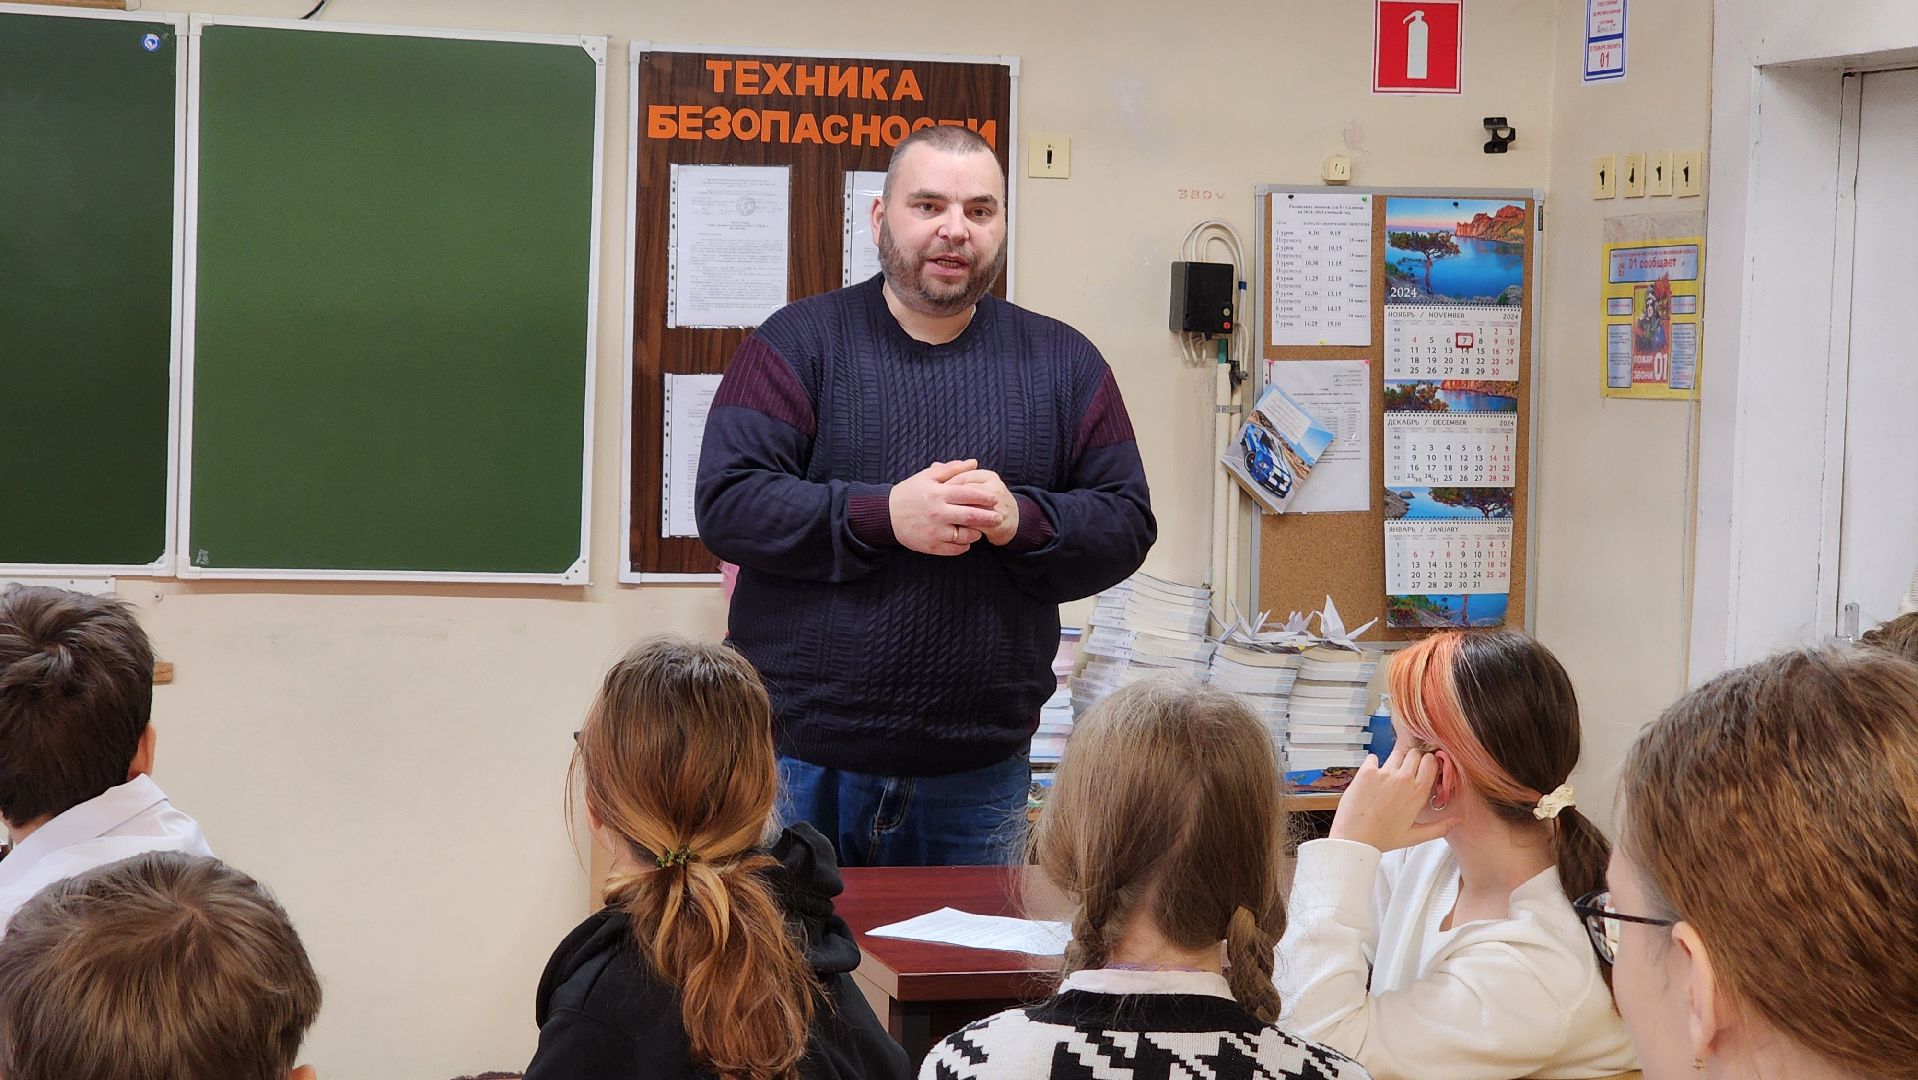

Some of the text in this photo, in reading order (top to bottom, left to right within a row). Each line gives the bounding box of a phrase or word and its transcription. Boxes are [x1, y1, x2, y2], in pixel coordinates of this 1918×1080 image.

[1600, 52, 1609, 68] 01
[705, 60, 923, 101] ТЕХНИКА
[648, 104, 997, 150] БЕЗОПАСНОИ
[1390, 287, 1417, 297] 2024
[1654, 352, 1667, 380] 01
